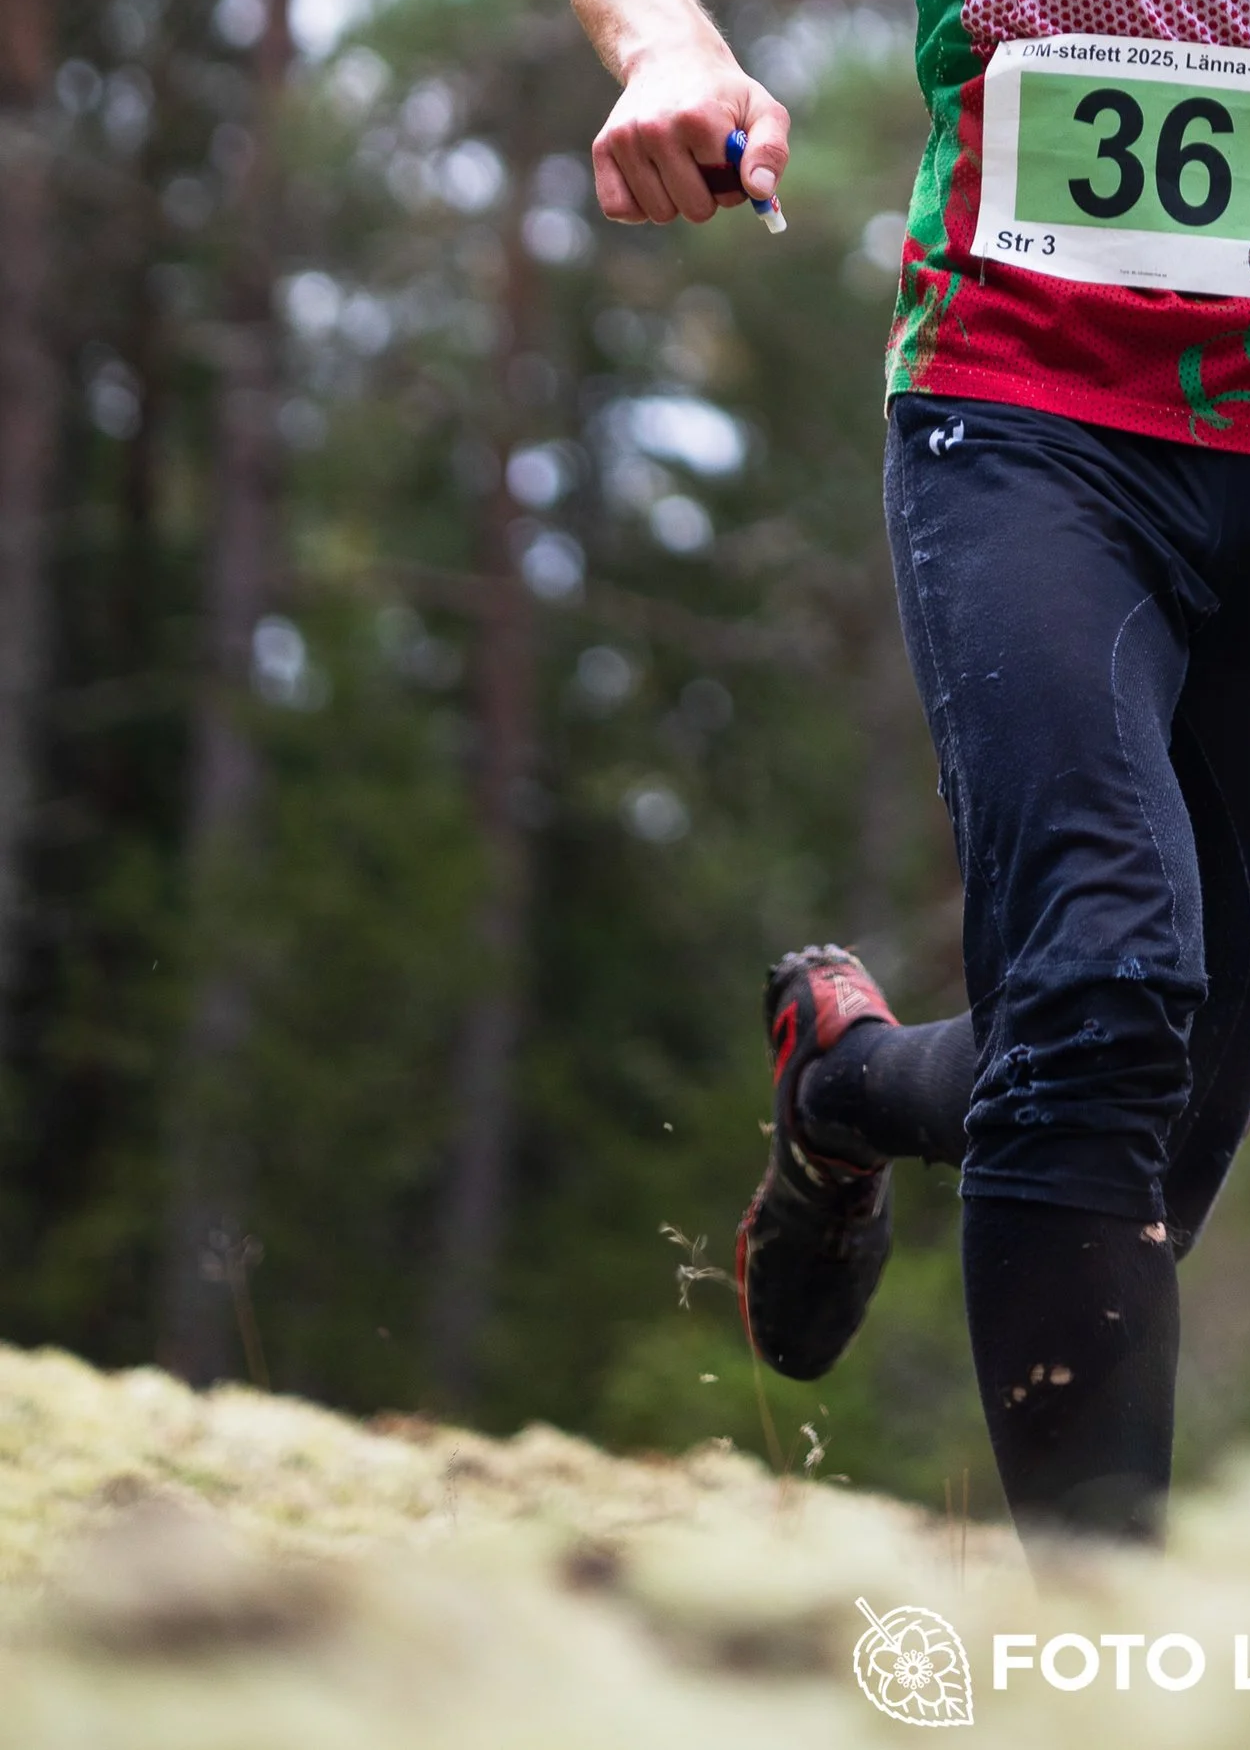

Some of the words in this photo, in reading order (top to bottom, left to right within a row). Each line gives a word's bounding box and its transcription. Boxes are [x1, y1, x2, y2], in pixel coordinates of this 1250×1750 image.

[1022, 43, 1121, 64] DM-stafett
[1127, 47, 1179, 71] 2025,
[1068, 88, 1235, 228] 36
[996, 230, 1034, 255] Str
[1041, 235, 1056, 256] 3
